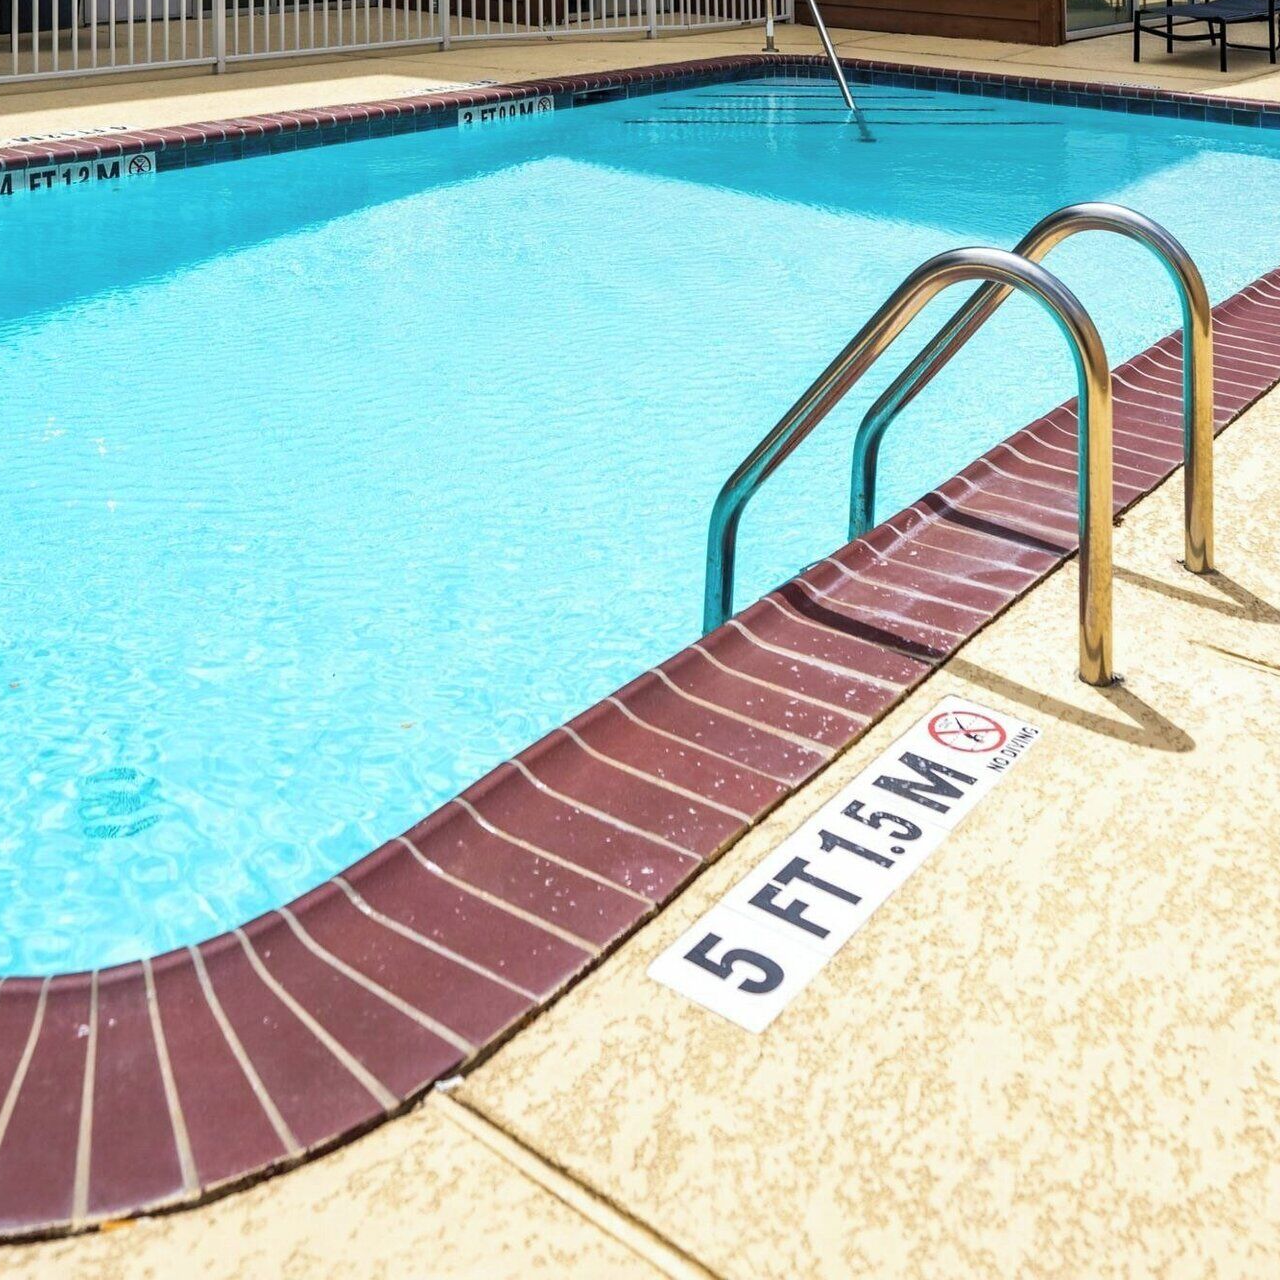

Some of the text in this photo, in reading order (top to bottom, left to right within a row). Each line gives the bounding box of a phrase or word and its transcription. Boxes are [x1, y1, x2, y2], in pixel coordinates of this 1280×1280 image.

[520, 102, 533, 115] M
[0, 173, 14, 195] 4
[30, 170, 56, 191] FT
[97, 161, 120, 180] M
[986, 726, 1039, 773] NO DIVING
[683, 751, 978, 994] 5 FT 1.5 M
